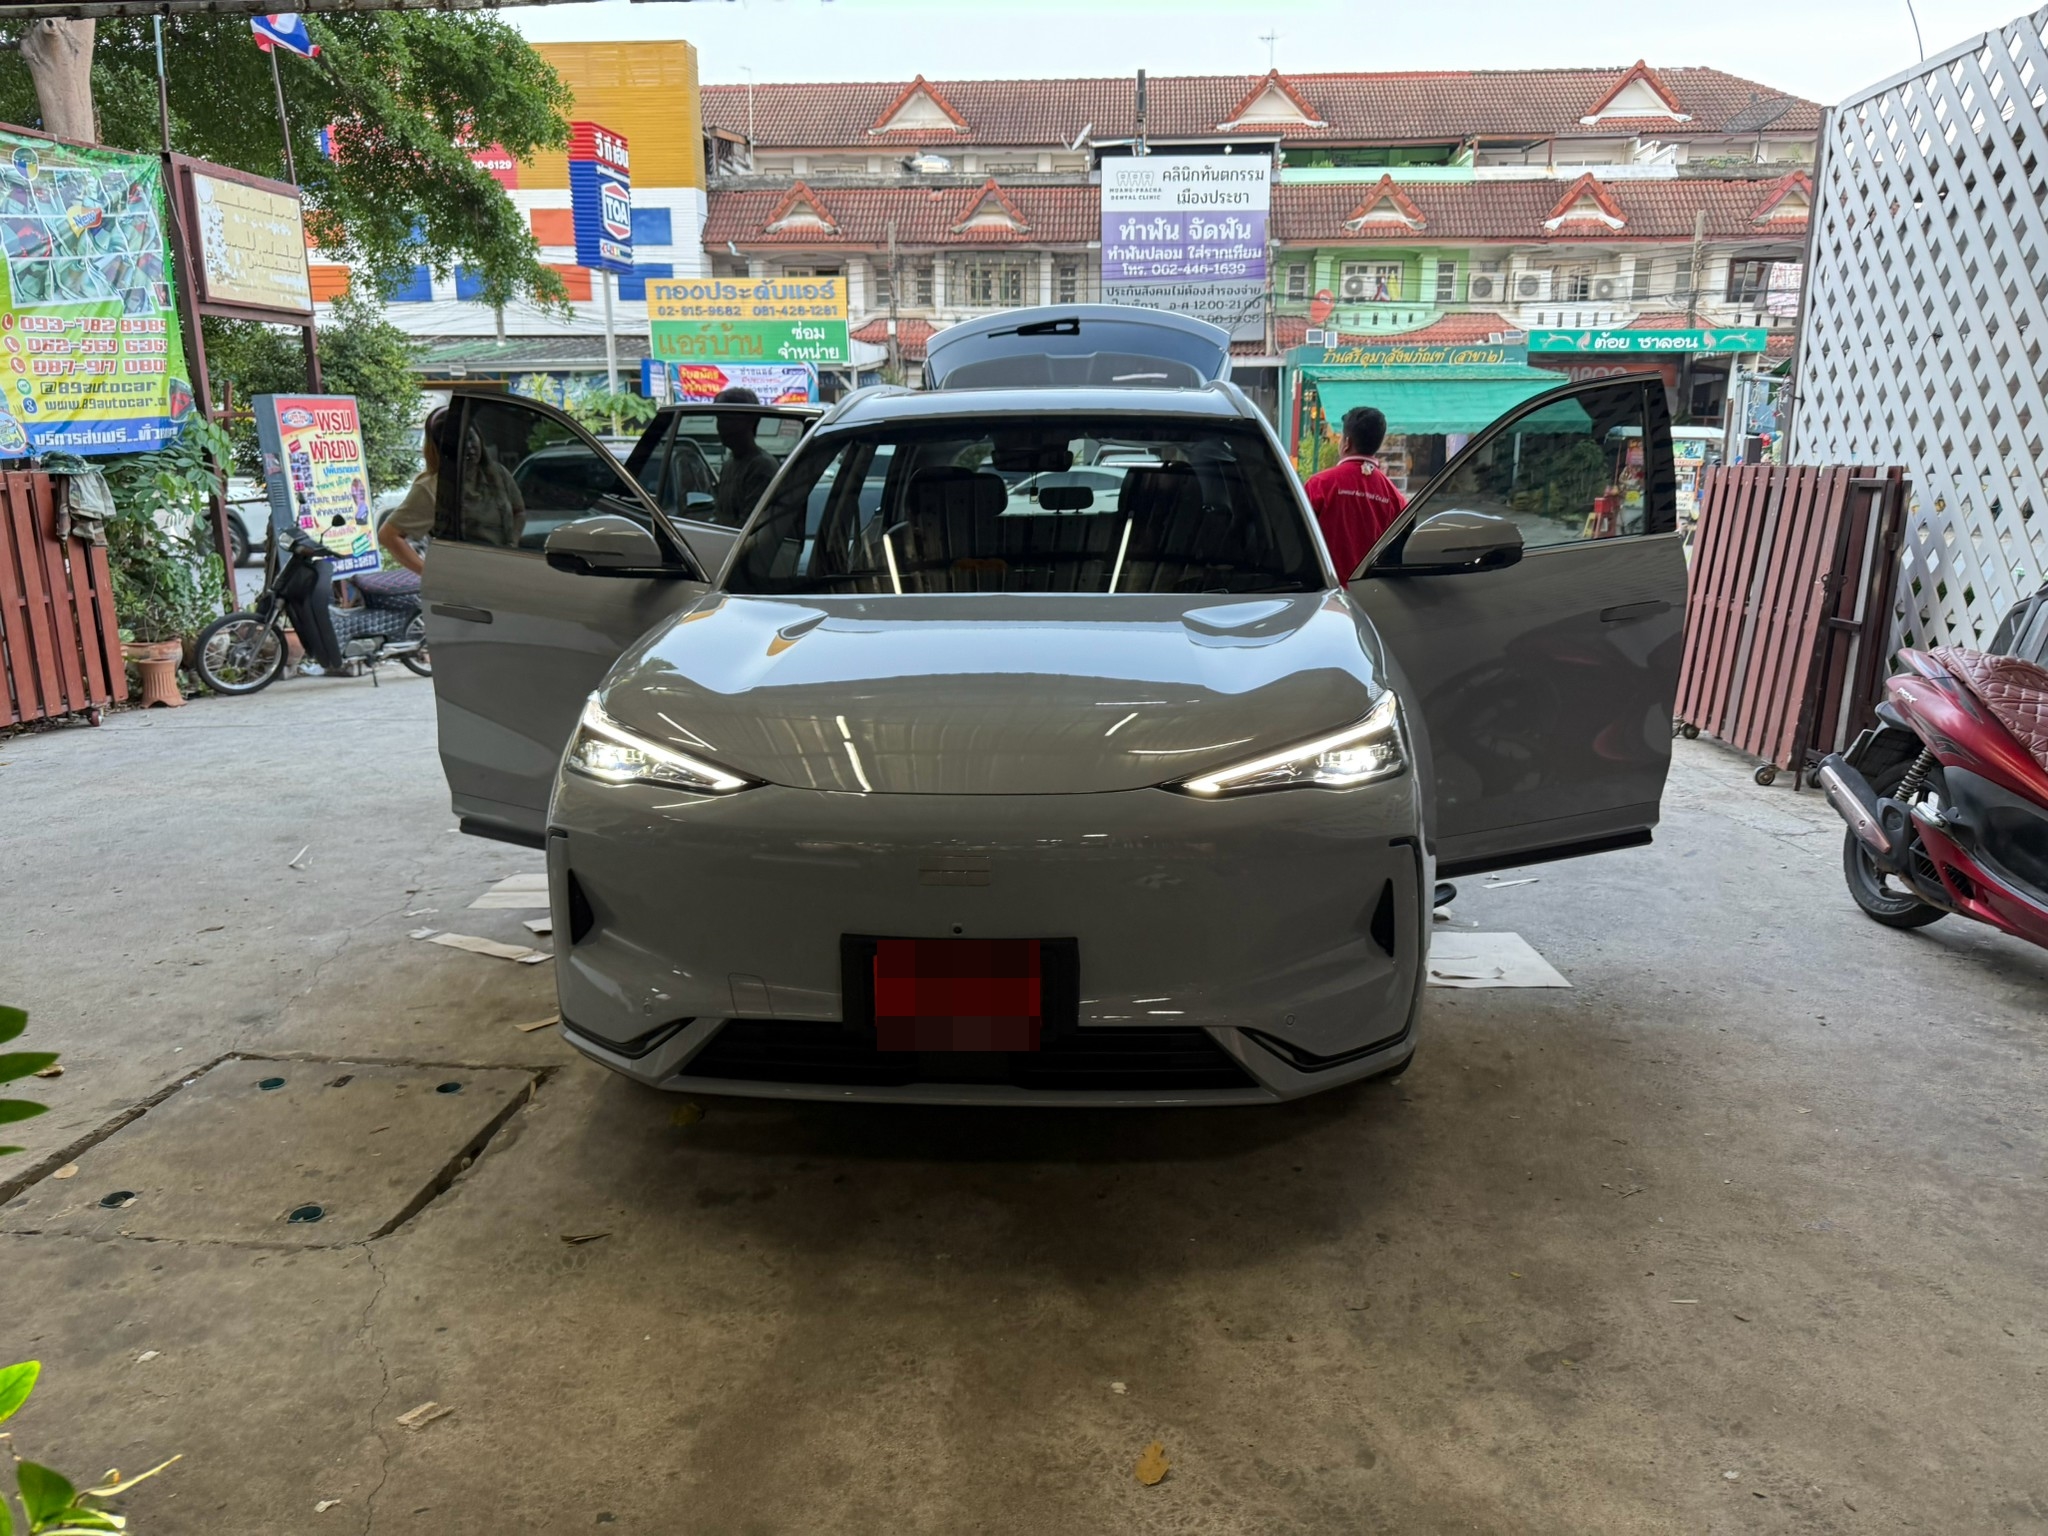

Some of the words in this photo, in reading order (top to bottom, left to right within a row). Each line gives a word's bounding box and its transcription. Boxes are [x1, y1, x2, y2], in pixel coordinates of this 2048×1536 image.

[1162, 165, 1265, 182] คลินิกทันตกรรม
[1177, 188, 1250, 205] เมืองประชา
[72, 209, 97, 228] New
[606, 196, 629, 225] TOA
[1119, 217, 1180, 241] ทำฟัน
[1189, 216, 1252, 240] จัดฟัน
[1107, 245, 1182, 261] ทำฟันปลอม
[655, 279, 836, 301] ทองประดับแอร์
[19, 315, 117, 333] 093-782
[791, 320, 825, 340] ซ่อม
[123, 337, 168, 353] 636
[658, 322, 764, 356] แอร์บ้าน
[1594, 331, 1630, 349] ต้อย
[777, 341, 840, 360] จำหน่าย
[122, 358, 167, 374] 080
[40, 380, 157, 395] @89autocar
[315, 409, 354, 434] พรม
